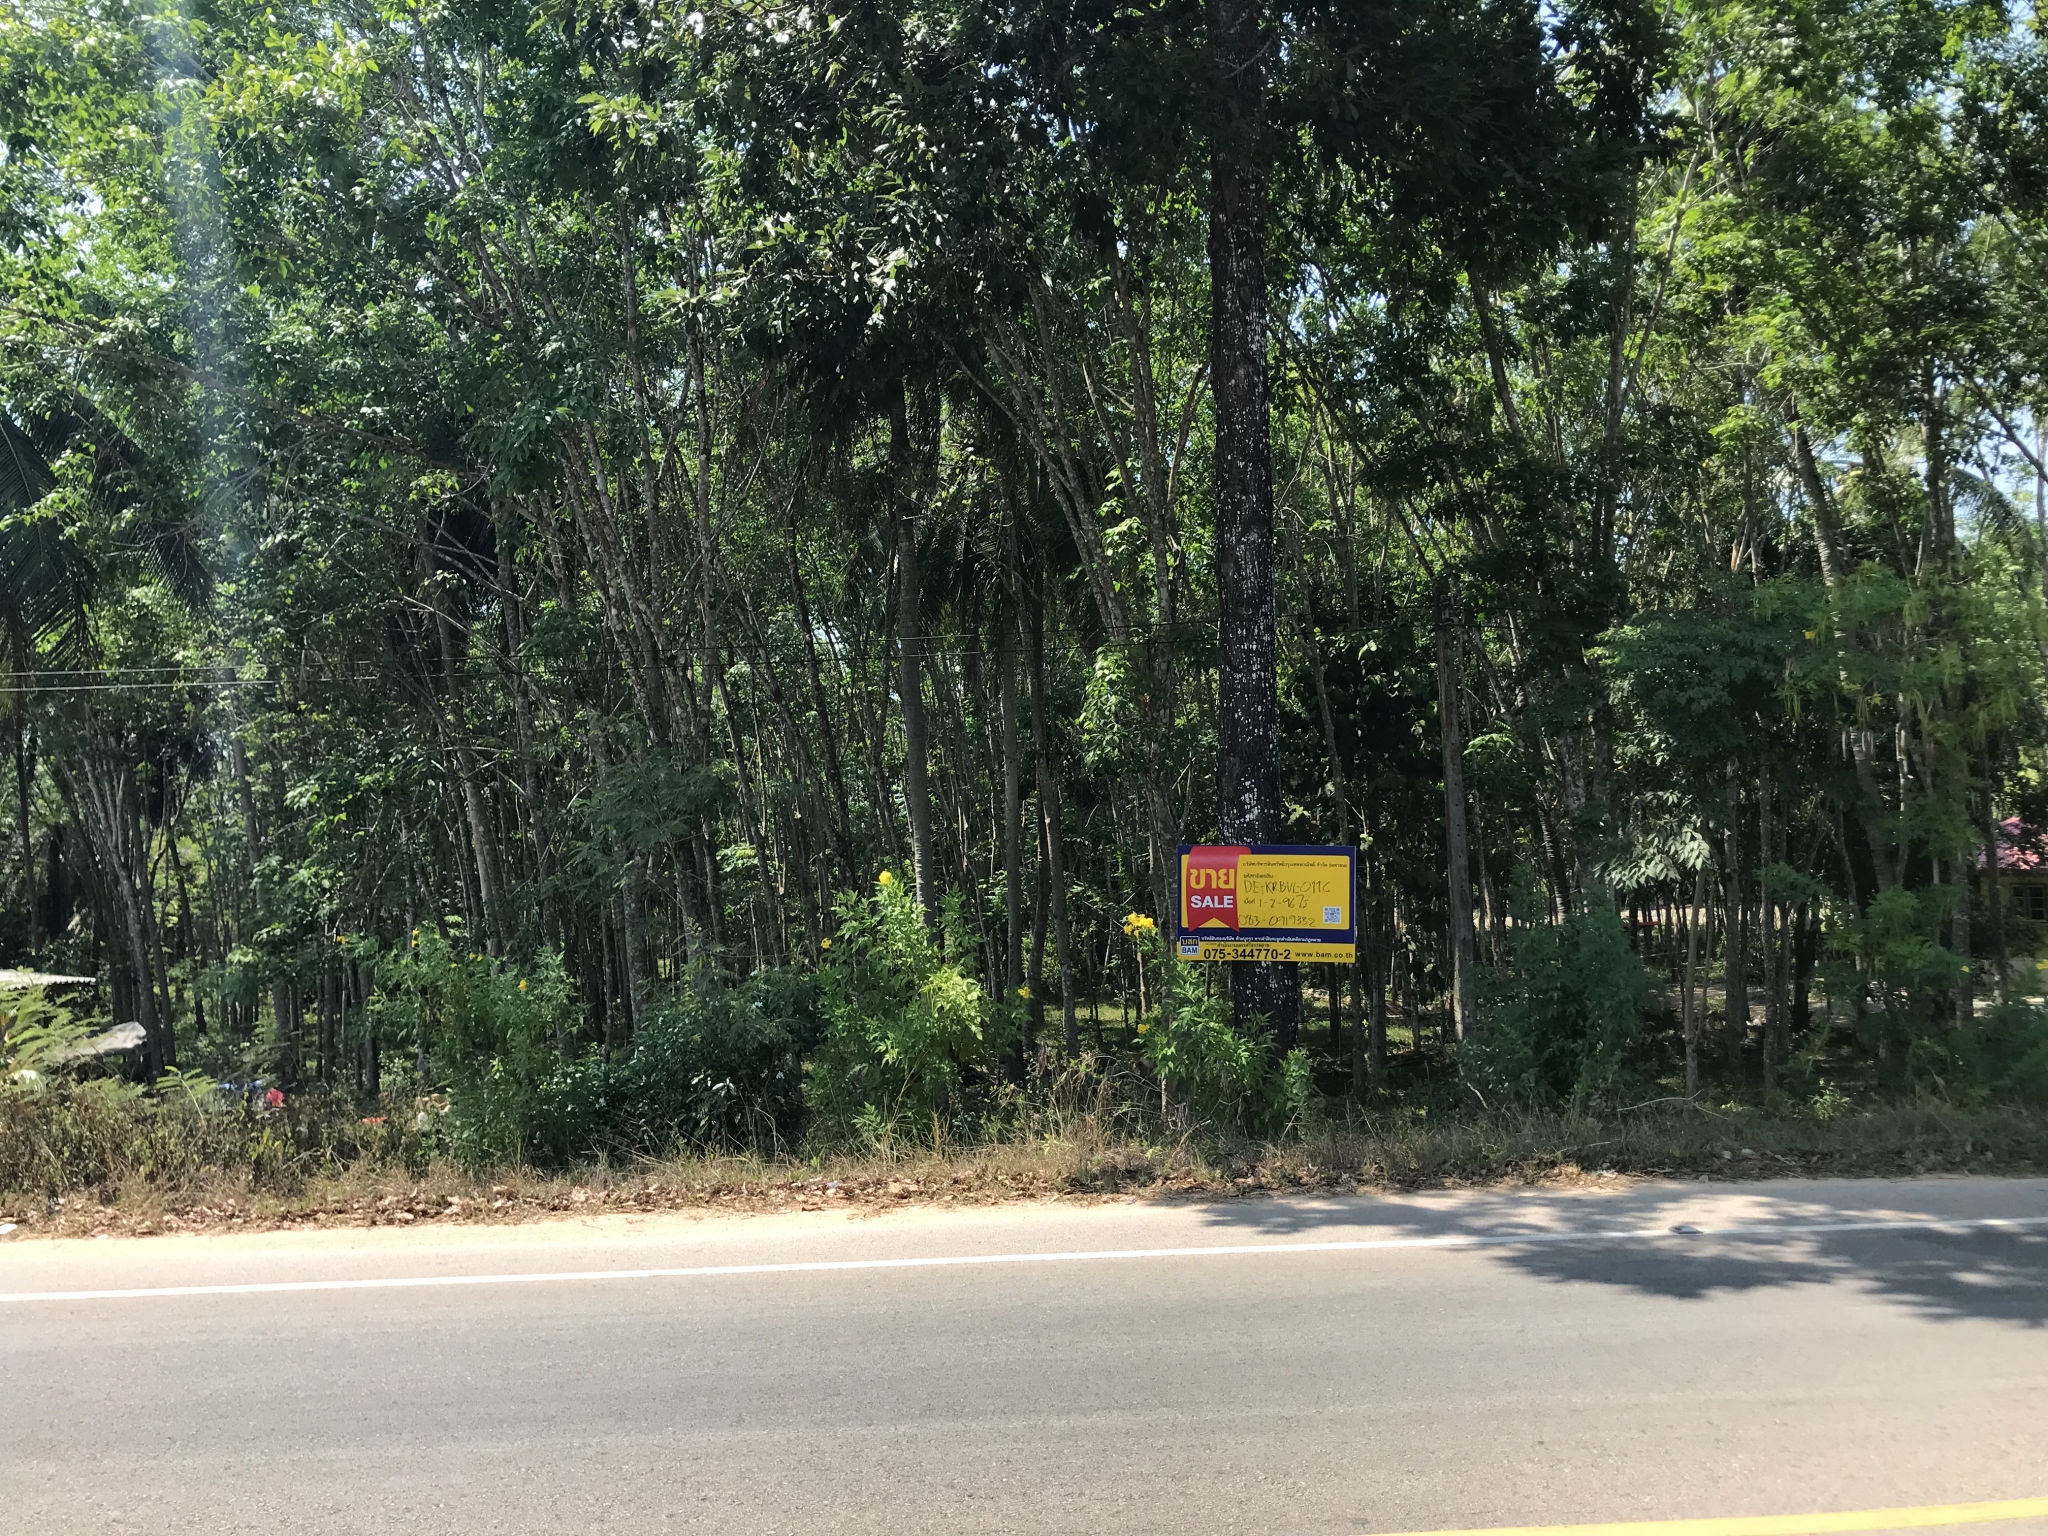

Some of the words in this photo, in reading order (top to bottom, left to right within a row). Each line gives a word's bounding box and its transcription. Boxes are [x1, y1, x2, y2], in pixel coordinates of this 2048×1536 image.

[1189, 868, 1235, 889] ขาย
[1190, 895, 1234, 908] SALE
[1181, 946, 1198, 954] BAM
[1203, 948, 1291, 960] 075-344770-2
[1294, 951, 1353, 959] www.bam.co.th
